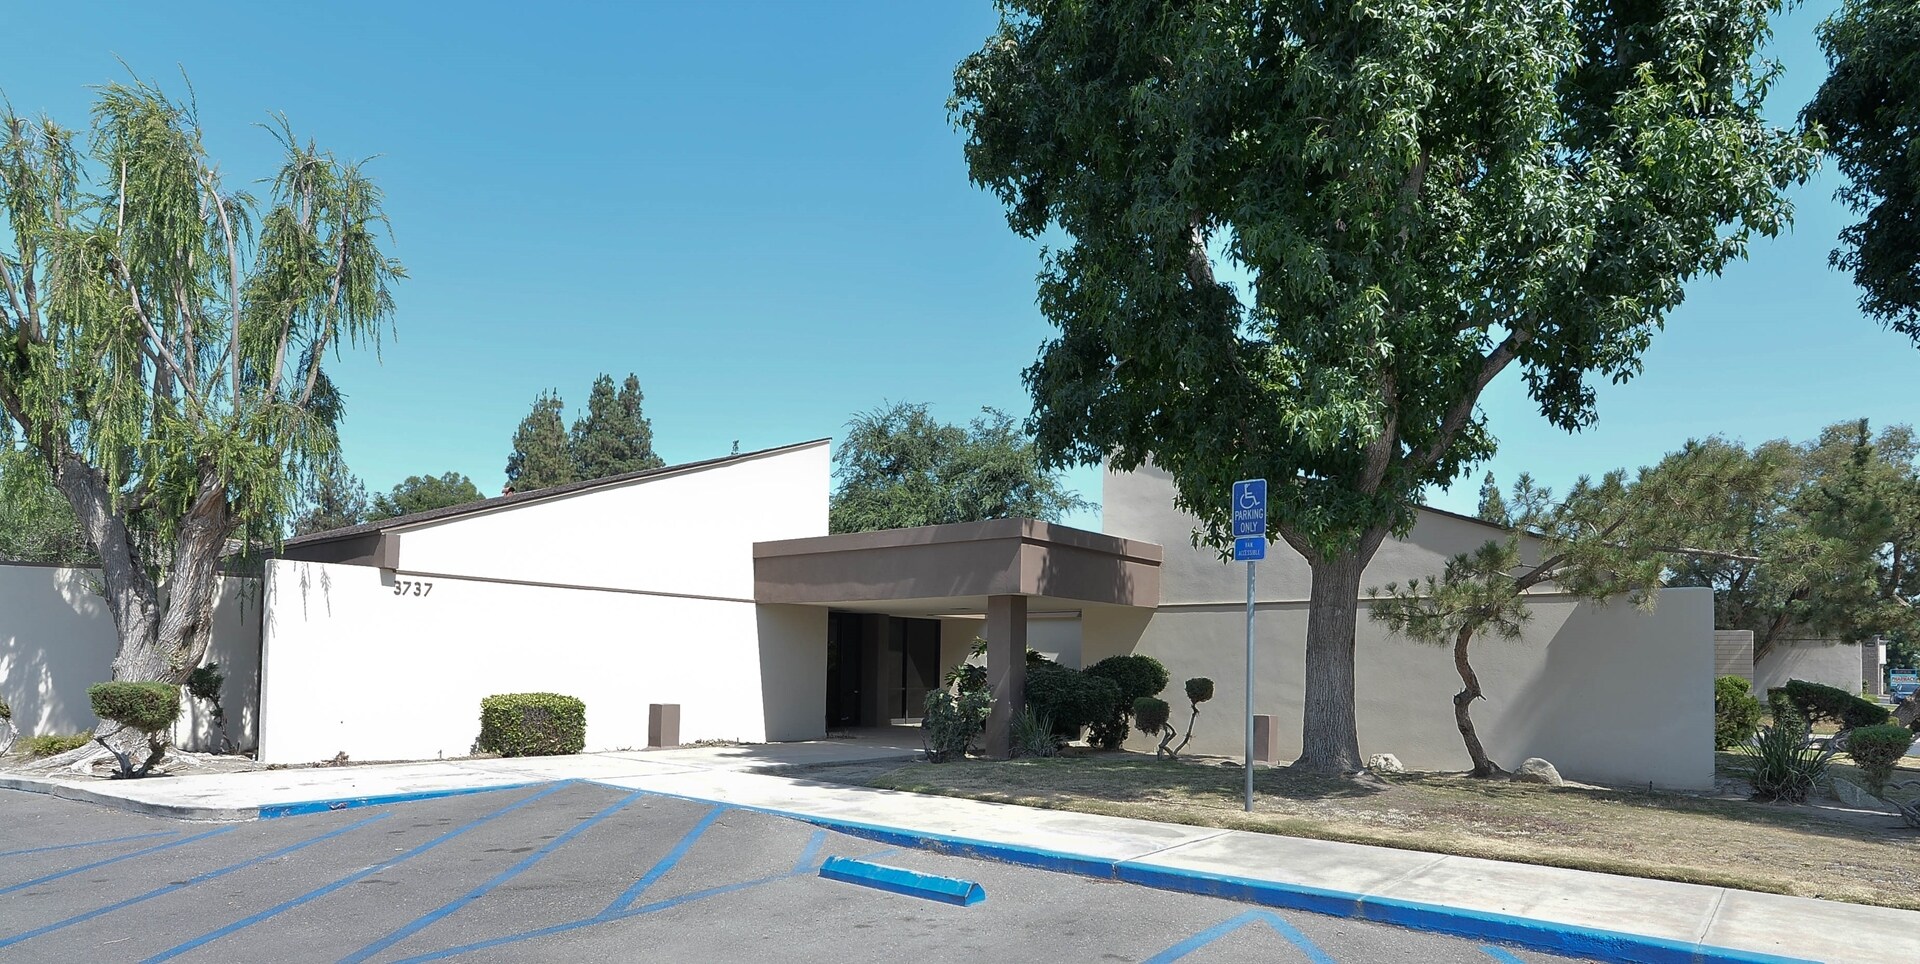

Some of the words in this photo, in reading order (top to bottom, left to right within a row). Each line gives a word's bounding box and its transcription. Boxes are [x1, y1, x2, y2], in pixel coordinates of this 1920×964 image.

[1235, 508, 1264, 521] PARKING
[1240, 521, 1258, 533] ONLY
[394, 581, 433, 598] 3737
